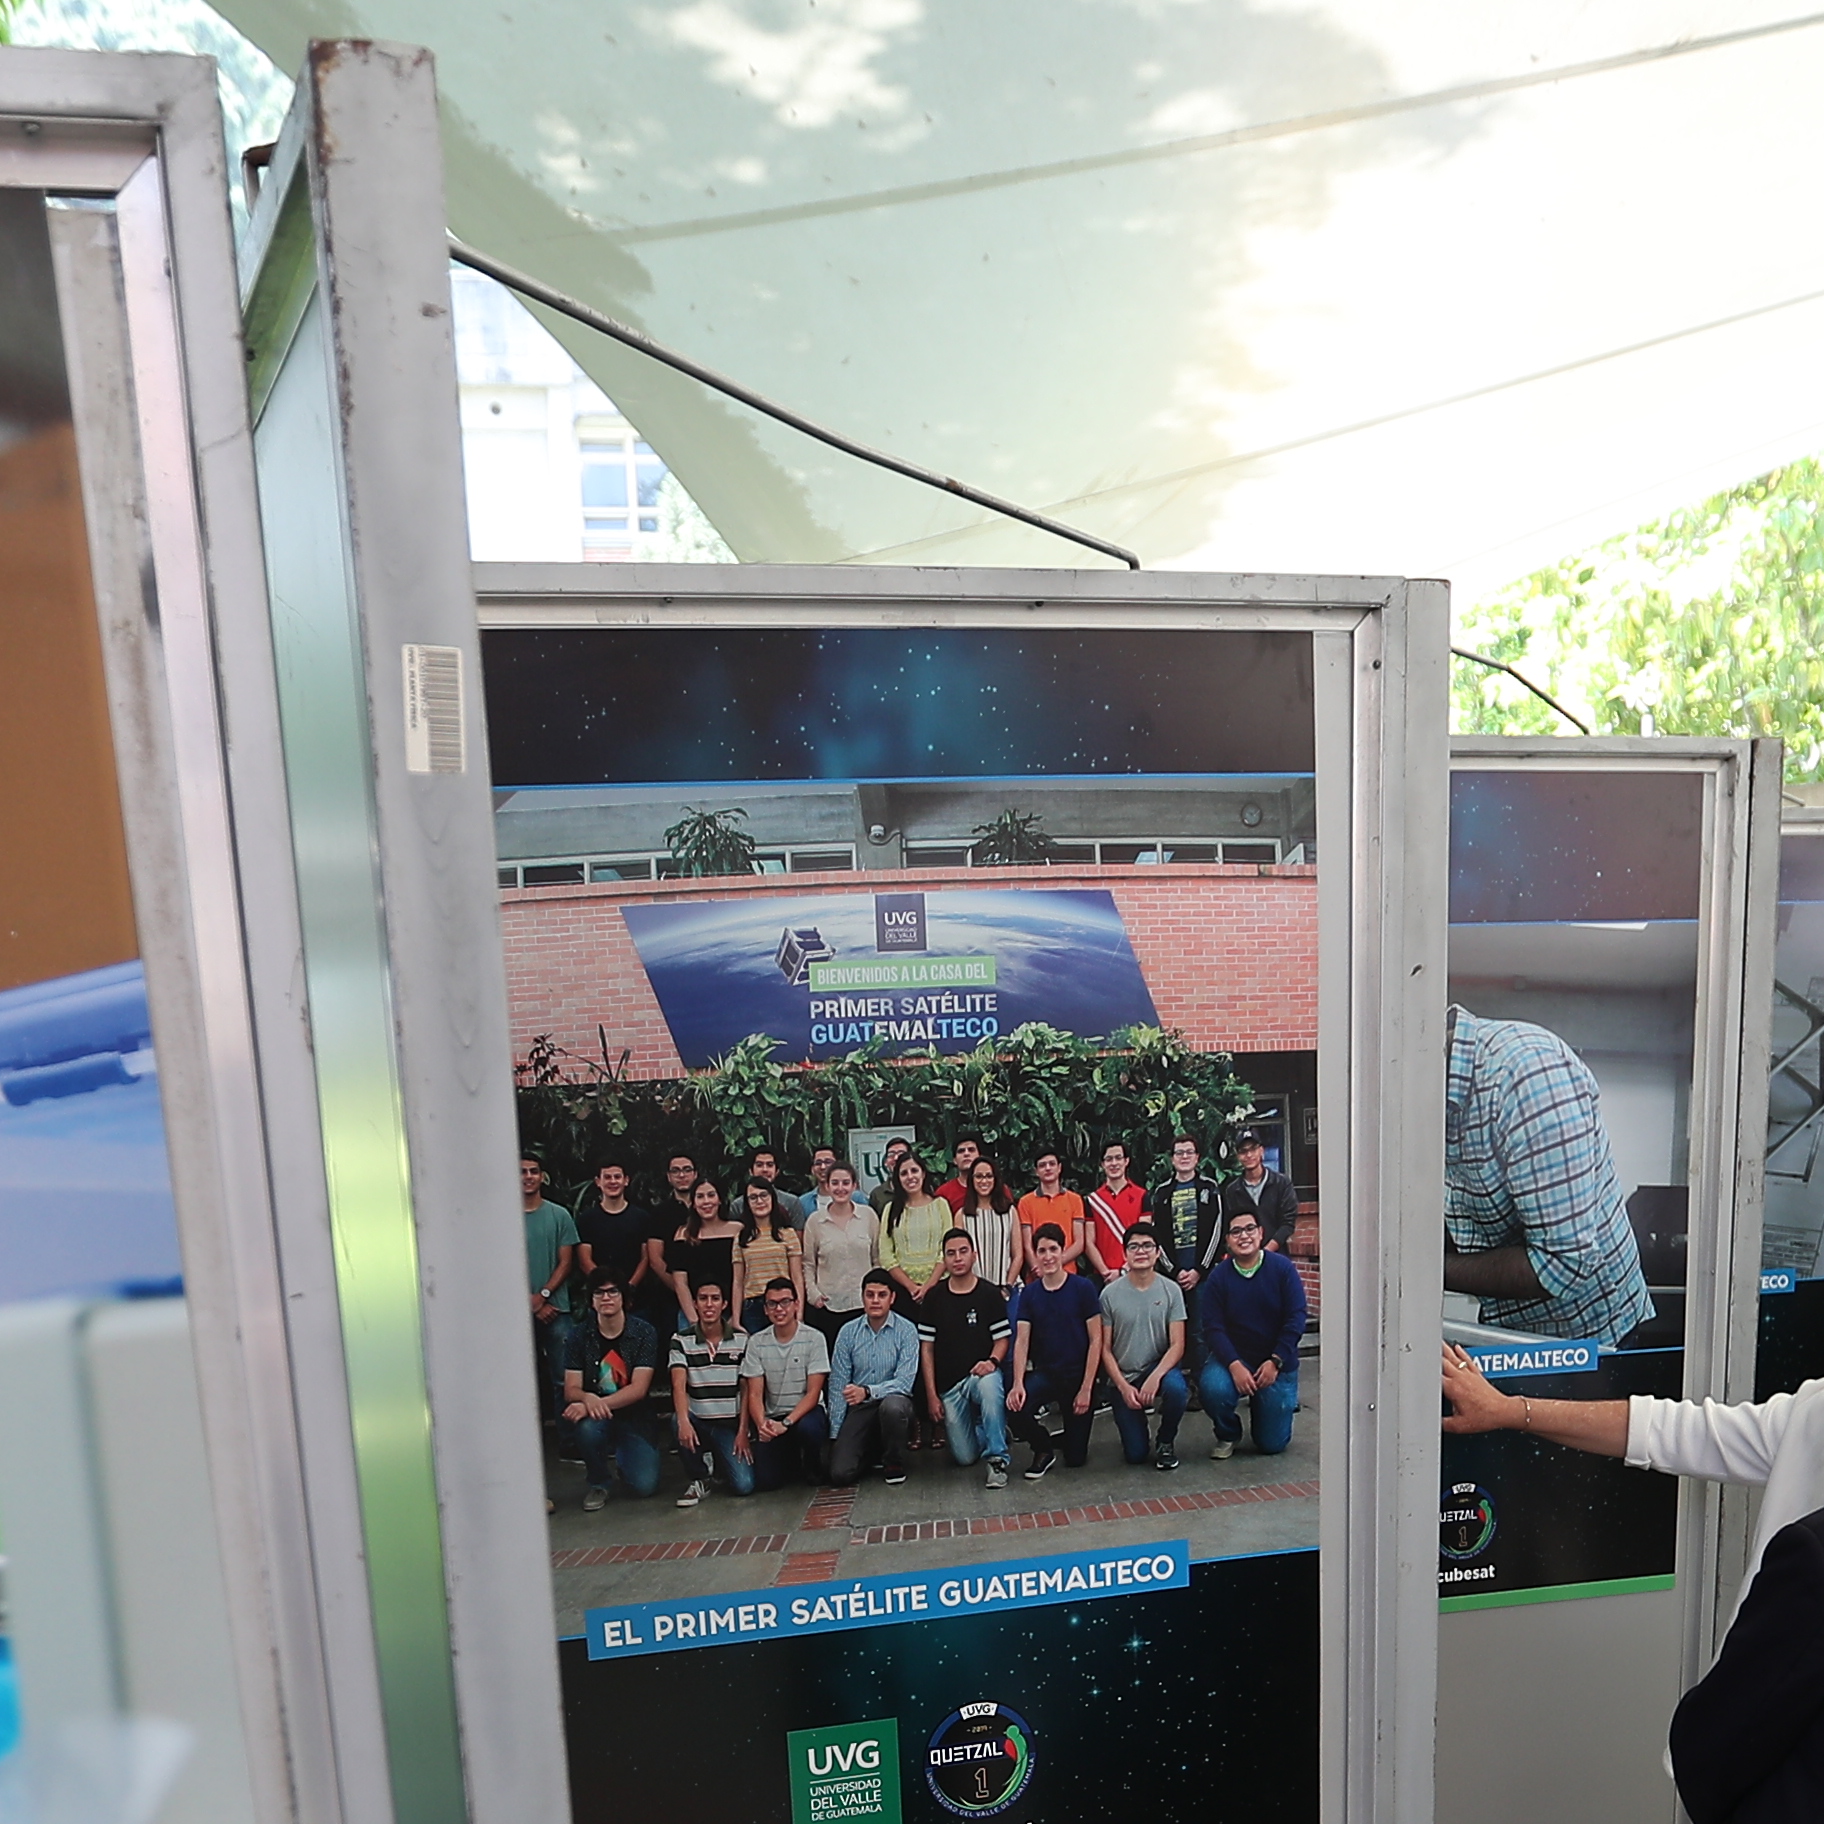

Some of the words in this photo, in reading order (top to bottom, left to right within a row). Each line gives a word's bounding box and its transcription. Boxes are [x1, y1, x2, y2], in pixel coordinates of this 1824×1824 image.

[884, 911, 917, 925] UVG
[817, 966, 898, 985] BIENVENIDOS
[900, 965, 910, 982] A
[913, 964, 928, 981] LA
[931, 963, 963, 981] CASA
[965, 962, 988, 979] DEL
[810, 998, 894, 1019] PRIMER
[900, 991, 998, 1016] SATÉLITE
[811, 1016, 999, 1045] GUATEMALTECO
[1760, 1274, 1789, 1290] ECO
[1472, 1347, 1589, 1373] ATEMALTECO
[1439, 1509, 1478, 1523] UETZAL
[1458, 1526, 1468, 1547] 1
[1438, 1565, 1495, 1583] cubesat
[603, 1618, 642, 1648] EL
[654, 1602, 777, 1642] PRIMER
[791, 1584, 929, 1625] SATÉLITE
[940, 1553, 1175, 1608] GUATEMALTECO
[966, 1704, 991, 1715] UVG
[807, 1740, 880, 1776] UVG
[930, 1741, 1003, 1766] QUETZAL
[810, 1778, 881, 1797] UNIVERSIDAD
[926, 1772, 958, 1812] UNIVERSIDAD
[959, 1810, 974, 1818] DEL
[976, 1808, 999, 1818] VALLE
[1010, 1757, 1035, 1802] GUATEMALA
[974, 1767, 990, 1798] 1
[811, 1796, 838, 1811] DEL
[840, 1789, 882, 1807] VALLE
[811, 1811, 825, 1821] DE
[826, 1803, 882, 1820] GUATEMALA
